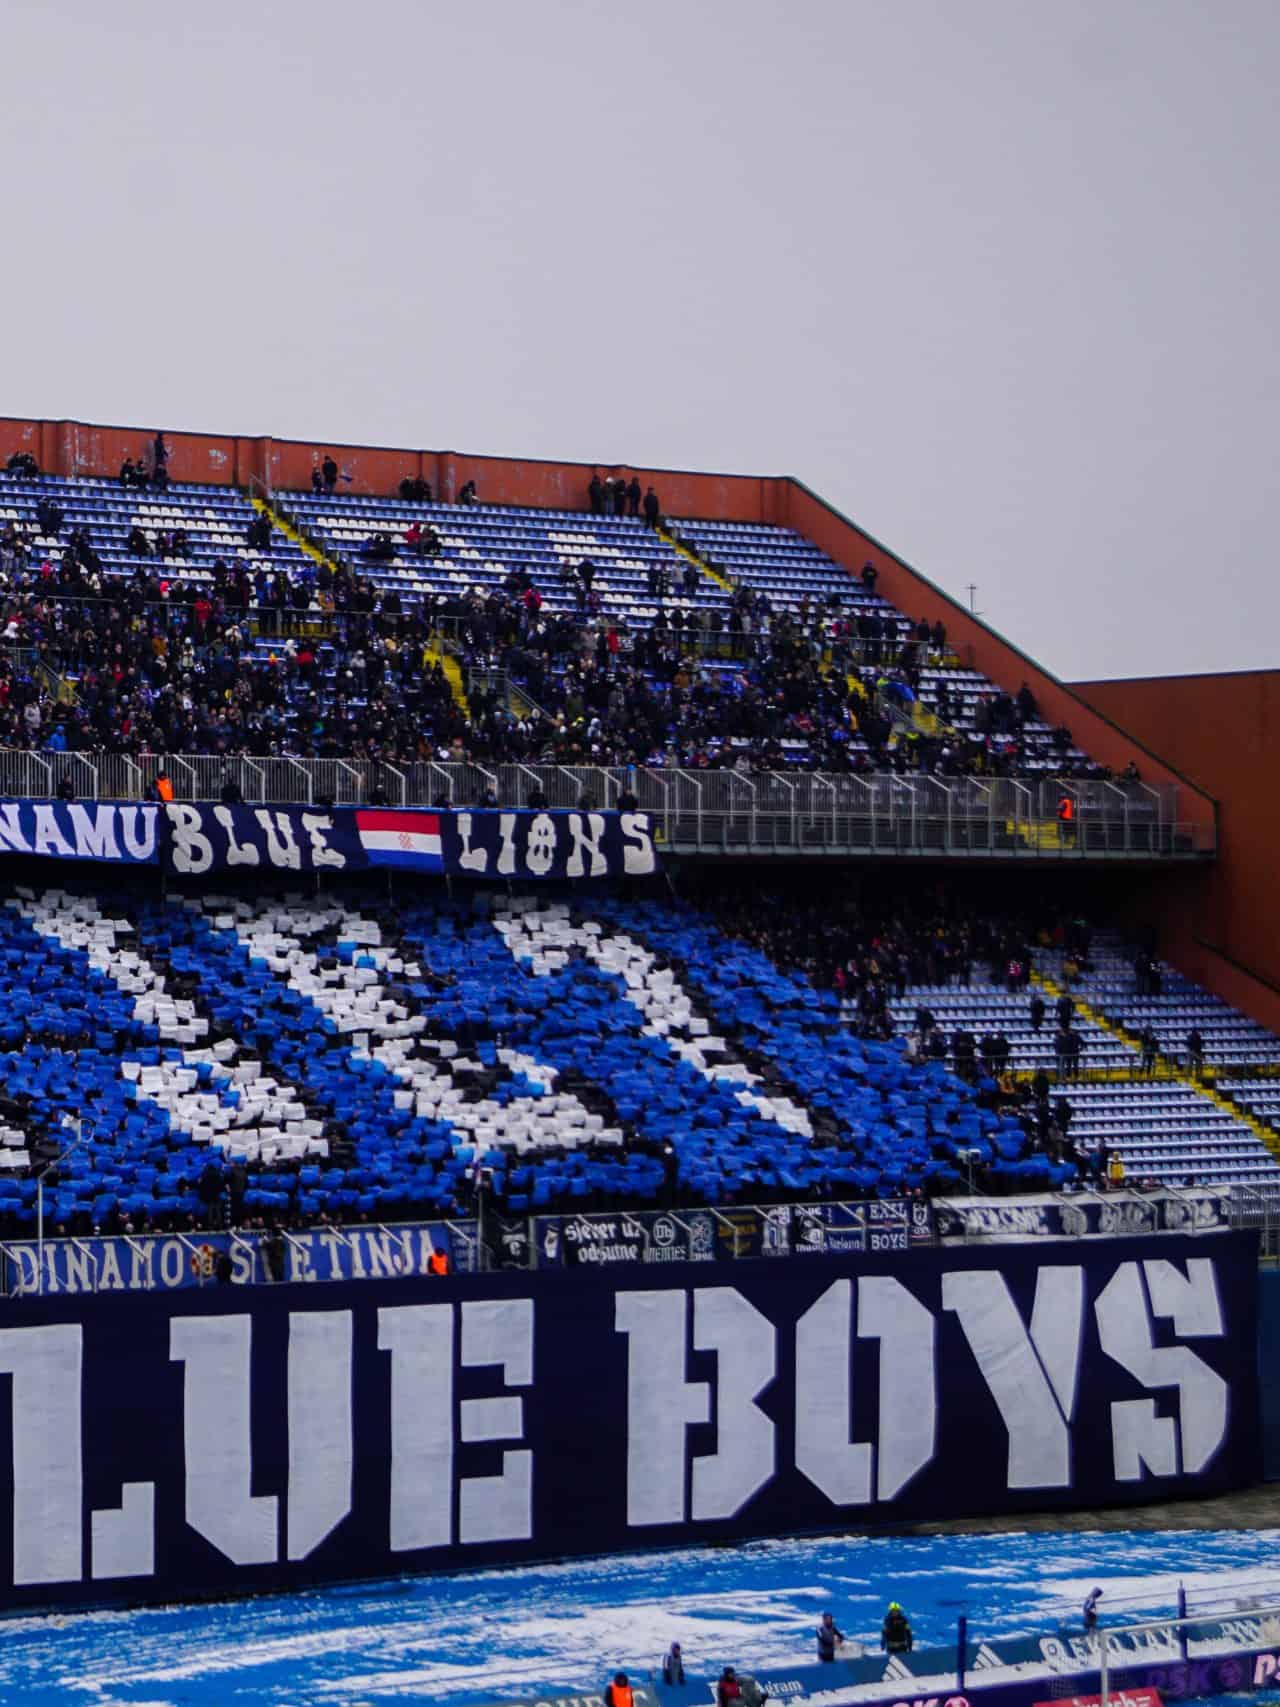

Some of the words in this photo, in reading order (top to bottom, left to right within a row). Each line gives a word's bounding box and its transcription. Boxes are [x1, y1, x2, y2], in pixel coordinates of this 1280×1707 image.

[166, 804, 347, 874] BLUE
[457, 812, 657, 877] LIONS
[14, 1234, 184, 1293] DINAMO
[871, 1234, 906, 1250] BOYS
[615, 1258, 1227, 1526] BOYS
